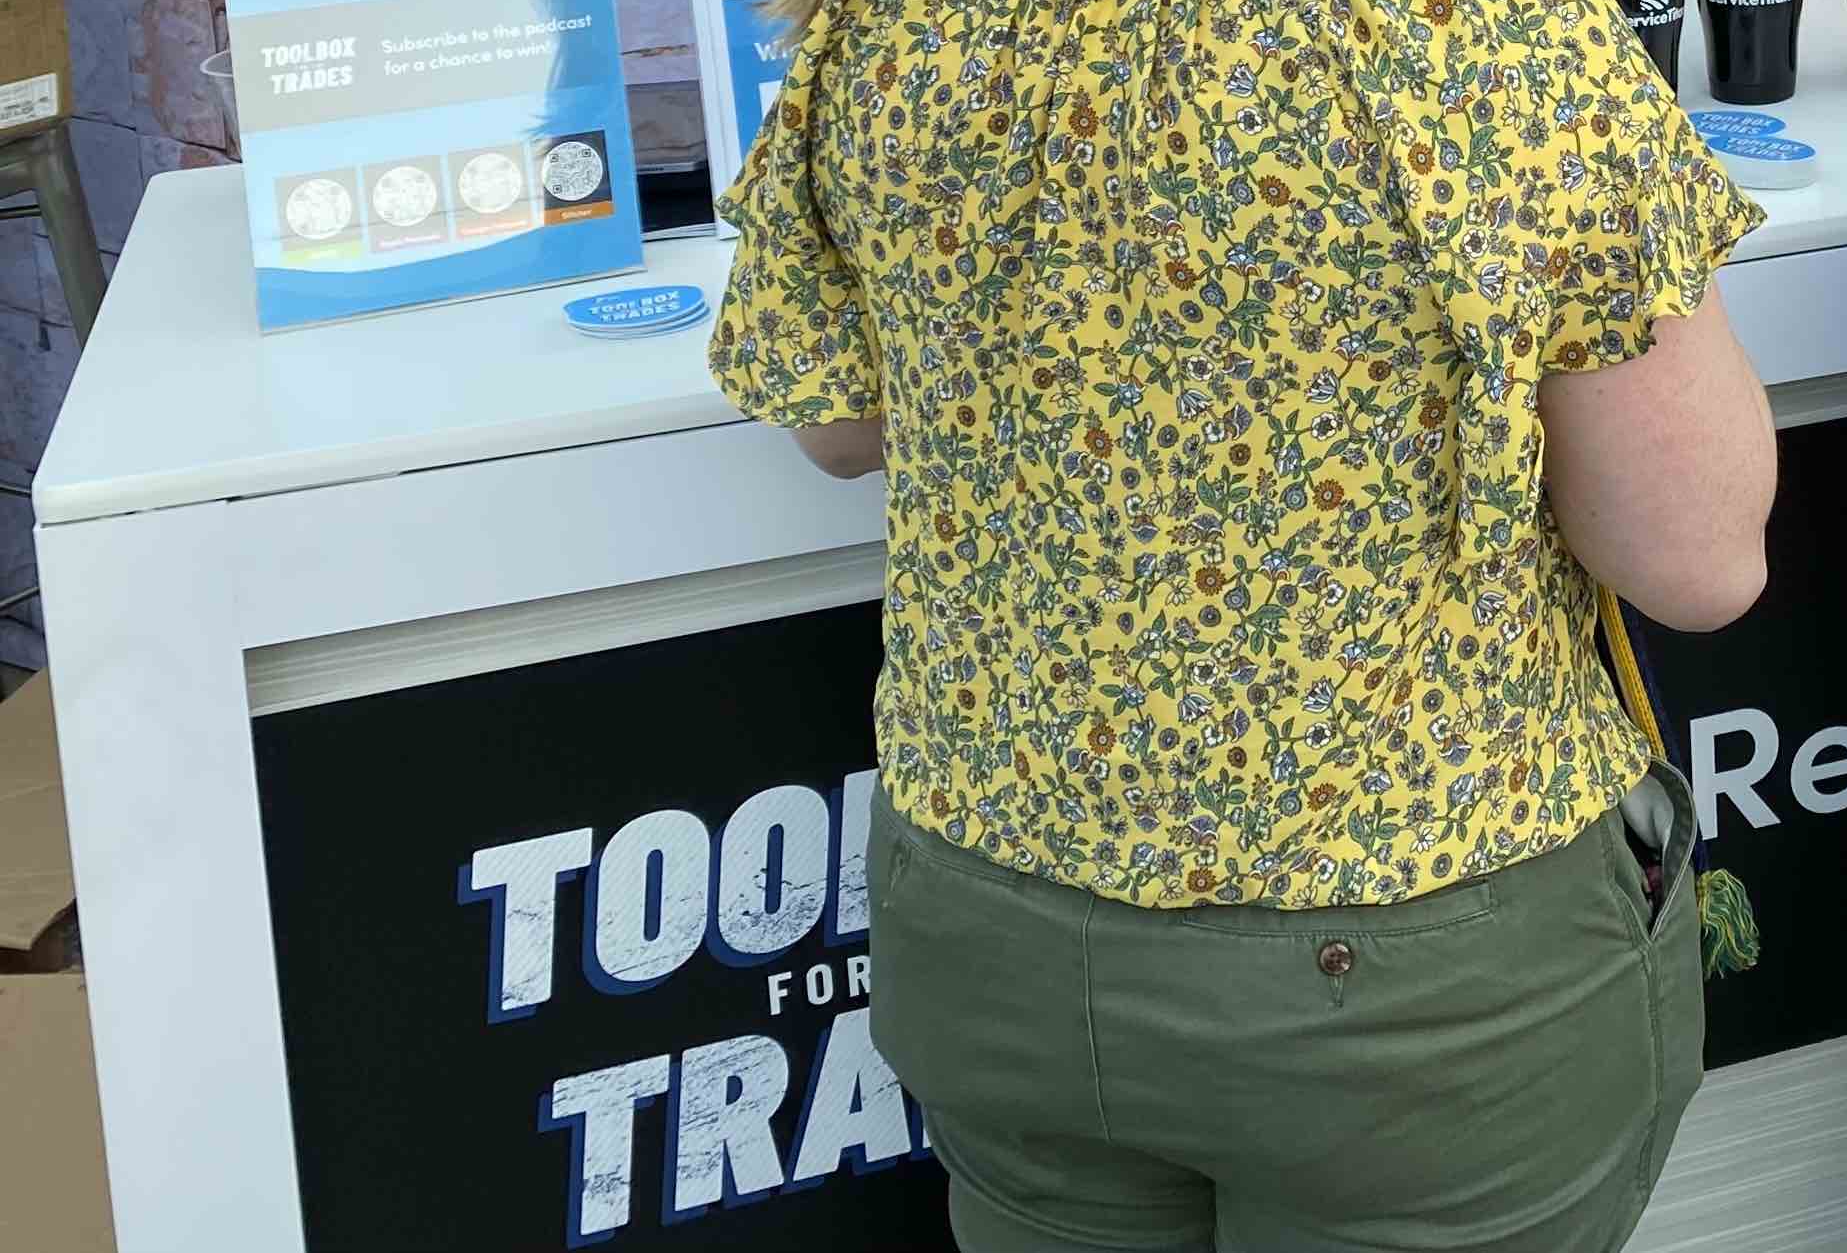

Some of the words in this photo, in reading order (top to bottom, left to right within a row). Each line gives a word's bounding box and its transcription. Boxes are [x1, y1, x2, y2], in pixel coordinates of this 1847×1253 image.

[381, 32, 468, 54] Subscribe
[472, 26, 488, 42] to
[492, 21, 521, 39] the
[525, 14, 593, 37] podcast
[261, 37, 357, 67] TOOLBOX
[383, 59, 407, 76] for
[413, 60, 425, 72] a
[429, 47, 492, 70] chance
[496, 44, 513, 61] to
[271, 66, 353, 94] TRADES
